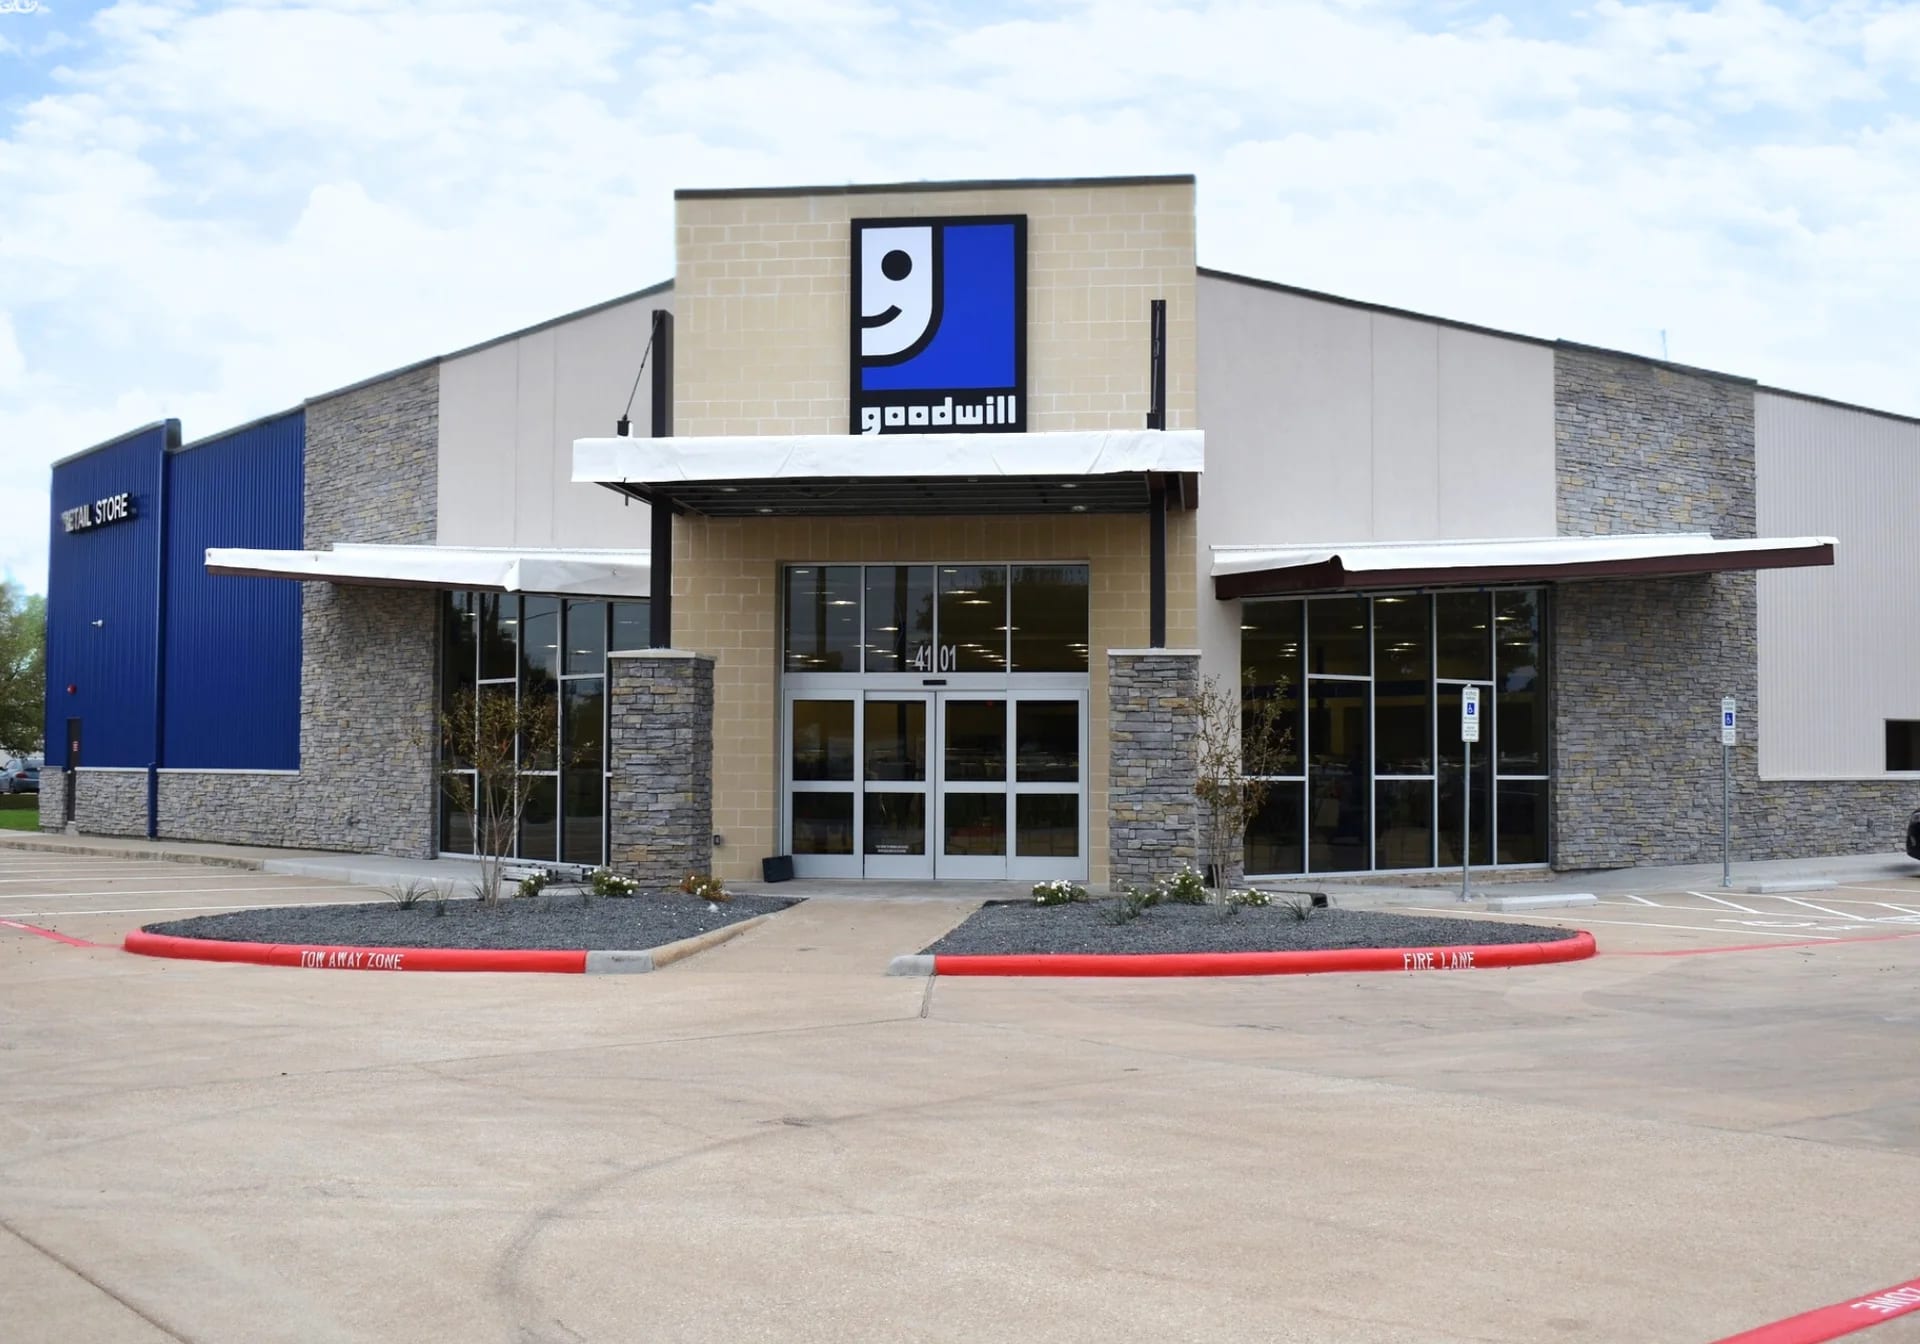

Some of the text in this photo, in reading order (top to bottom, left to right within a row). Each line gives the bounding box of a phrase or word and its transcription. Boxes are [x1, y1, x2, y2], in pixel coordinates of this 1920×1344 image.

[862, 395, 1016, 435] goodwill
[95, 492, 128, 524] STORE
[301, 950, 404, 969] TOW AWAY ZONE
[1403, 951, 1475, 970] FIRE LANE
